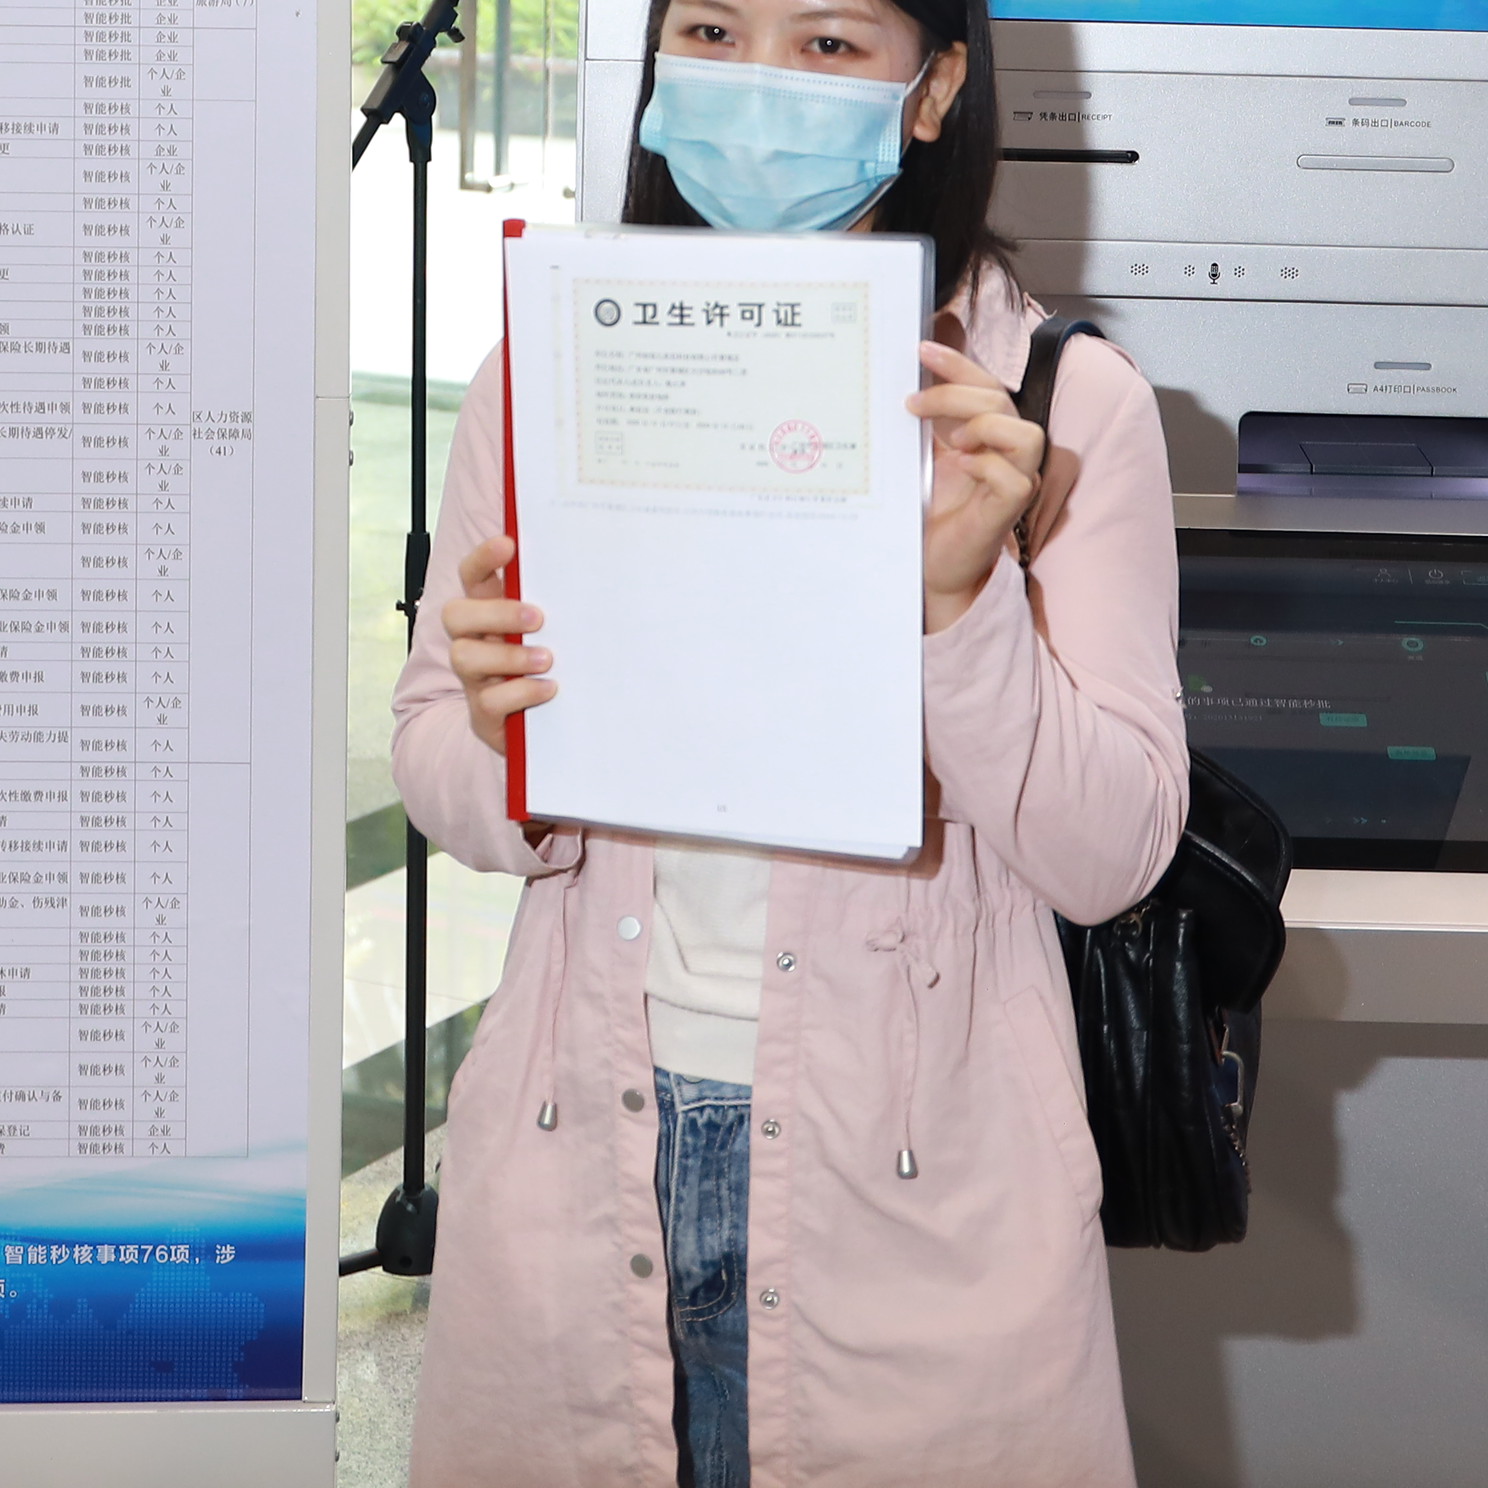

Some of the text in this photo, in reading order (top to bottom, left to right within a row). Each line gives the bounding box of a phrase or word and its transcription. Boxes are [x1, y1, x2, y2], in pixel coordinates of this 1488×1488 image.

[1039, 112, 1112, 121] 凭条出口 RECEIPT
[1352, 118, 1431, 128] 条码出口 BARCODE
[633, 301, 802, 327] 卫生许可证
[192, 410, 252, 424] 区人力资源
[192, 428, 252, 442] 社会保障局
[78, 1142, 125, 1156] 智能秒核
[149, 1142, 171, 1156] 个人
